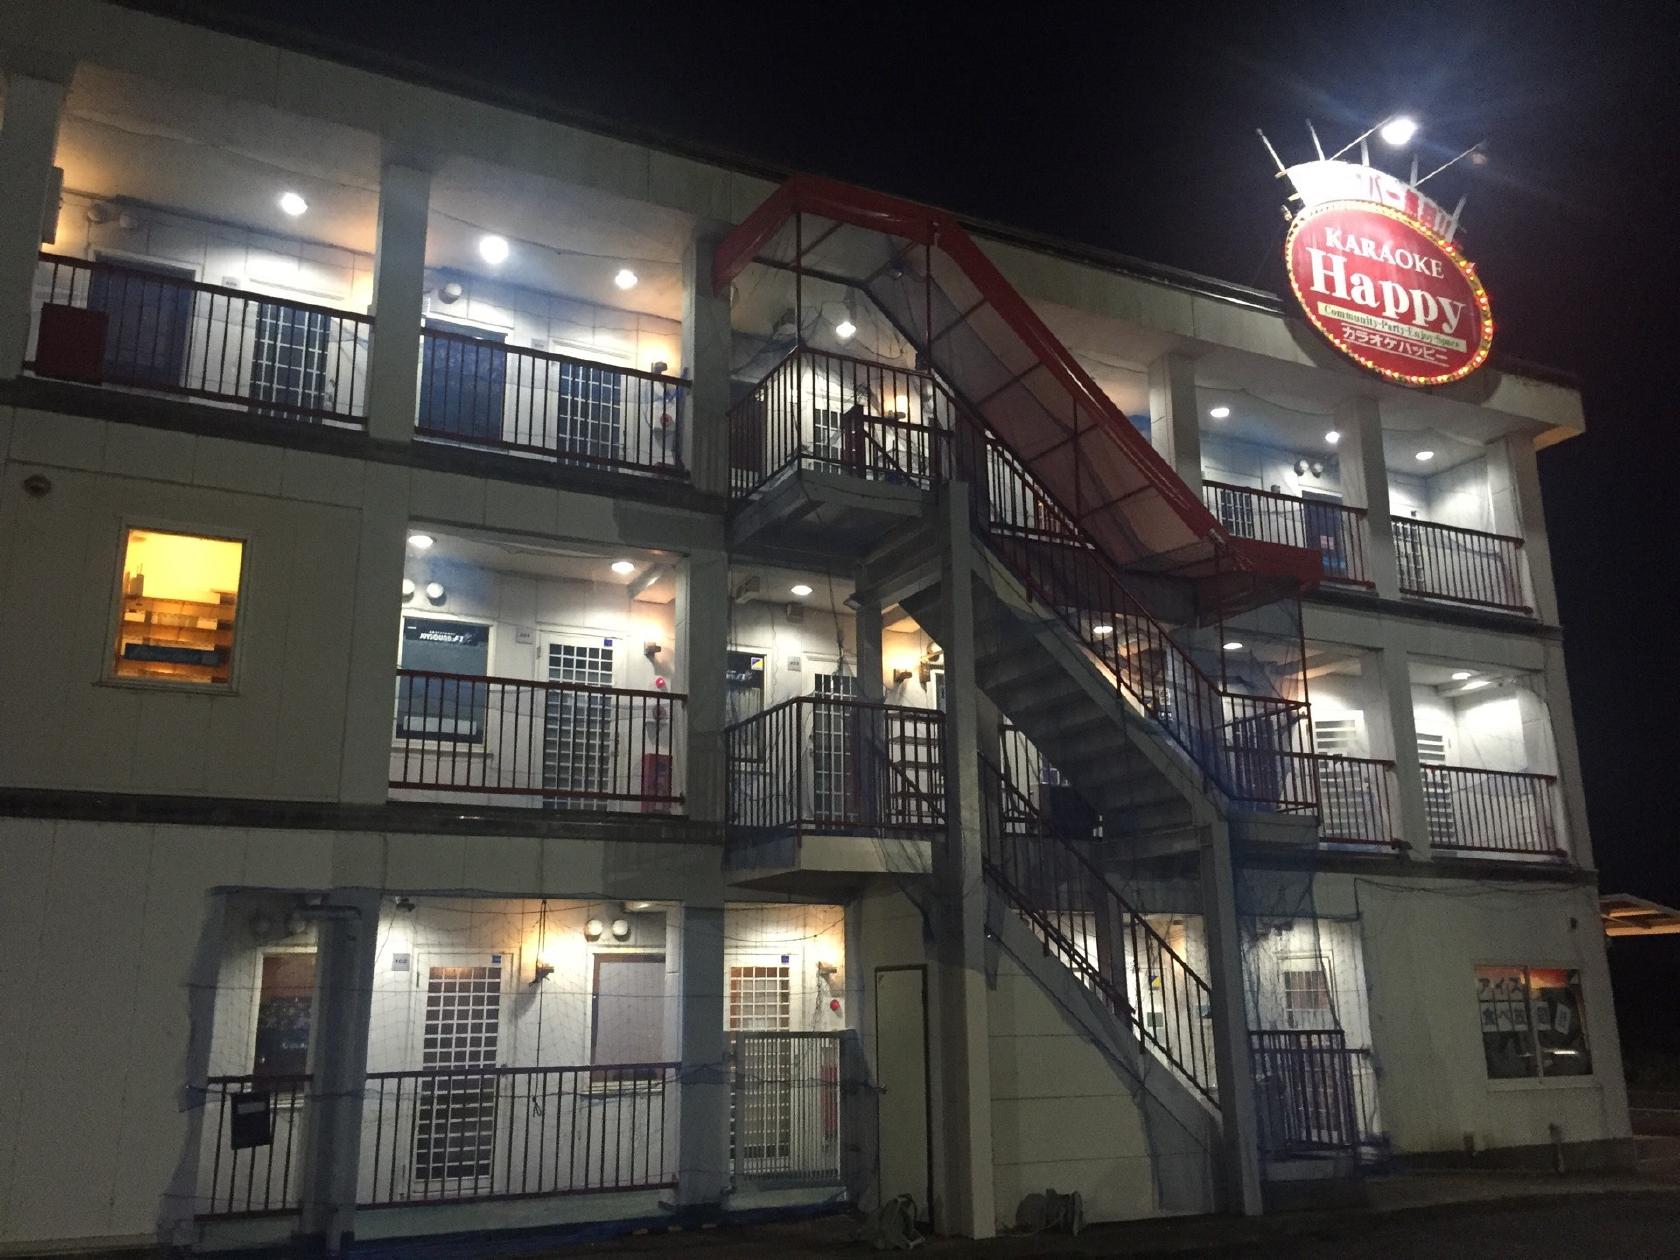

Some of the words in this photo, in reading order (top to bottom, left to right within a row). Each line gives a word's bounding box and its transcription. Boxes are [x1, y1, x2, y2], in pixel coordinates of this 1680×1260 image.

[1325, 227, 1444, 279] KARAOKE
[1306, 247, 1466, 333] Happy
[1342, 326, 1448, 360] カラオケハッピー
